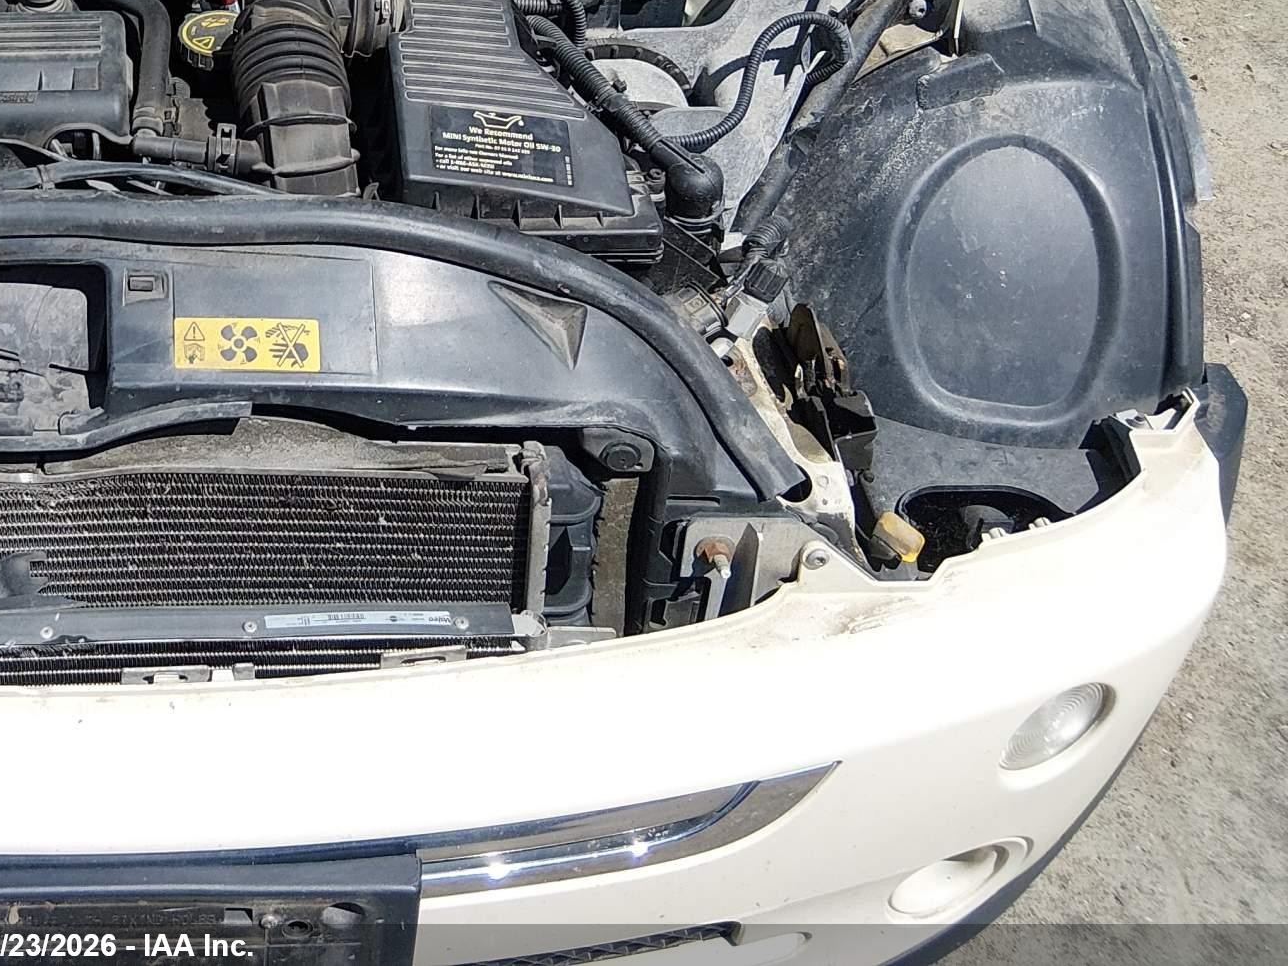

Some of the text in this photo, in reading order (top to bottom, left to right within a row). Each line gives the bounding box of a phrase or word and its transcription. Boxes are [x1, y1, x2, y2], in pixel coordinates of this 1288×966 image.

[442, 132, 461, 140] MINI
[462, 133, 497, 145] Synthetic
[499, 138, 522, 147] Motor
[523, 141, 534, 149] Oil
[469, 126, 533, 141] We Recommend
